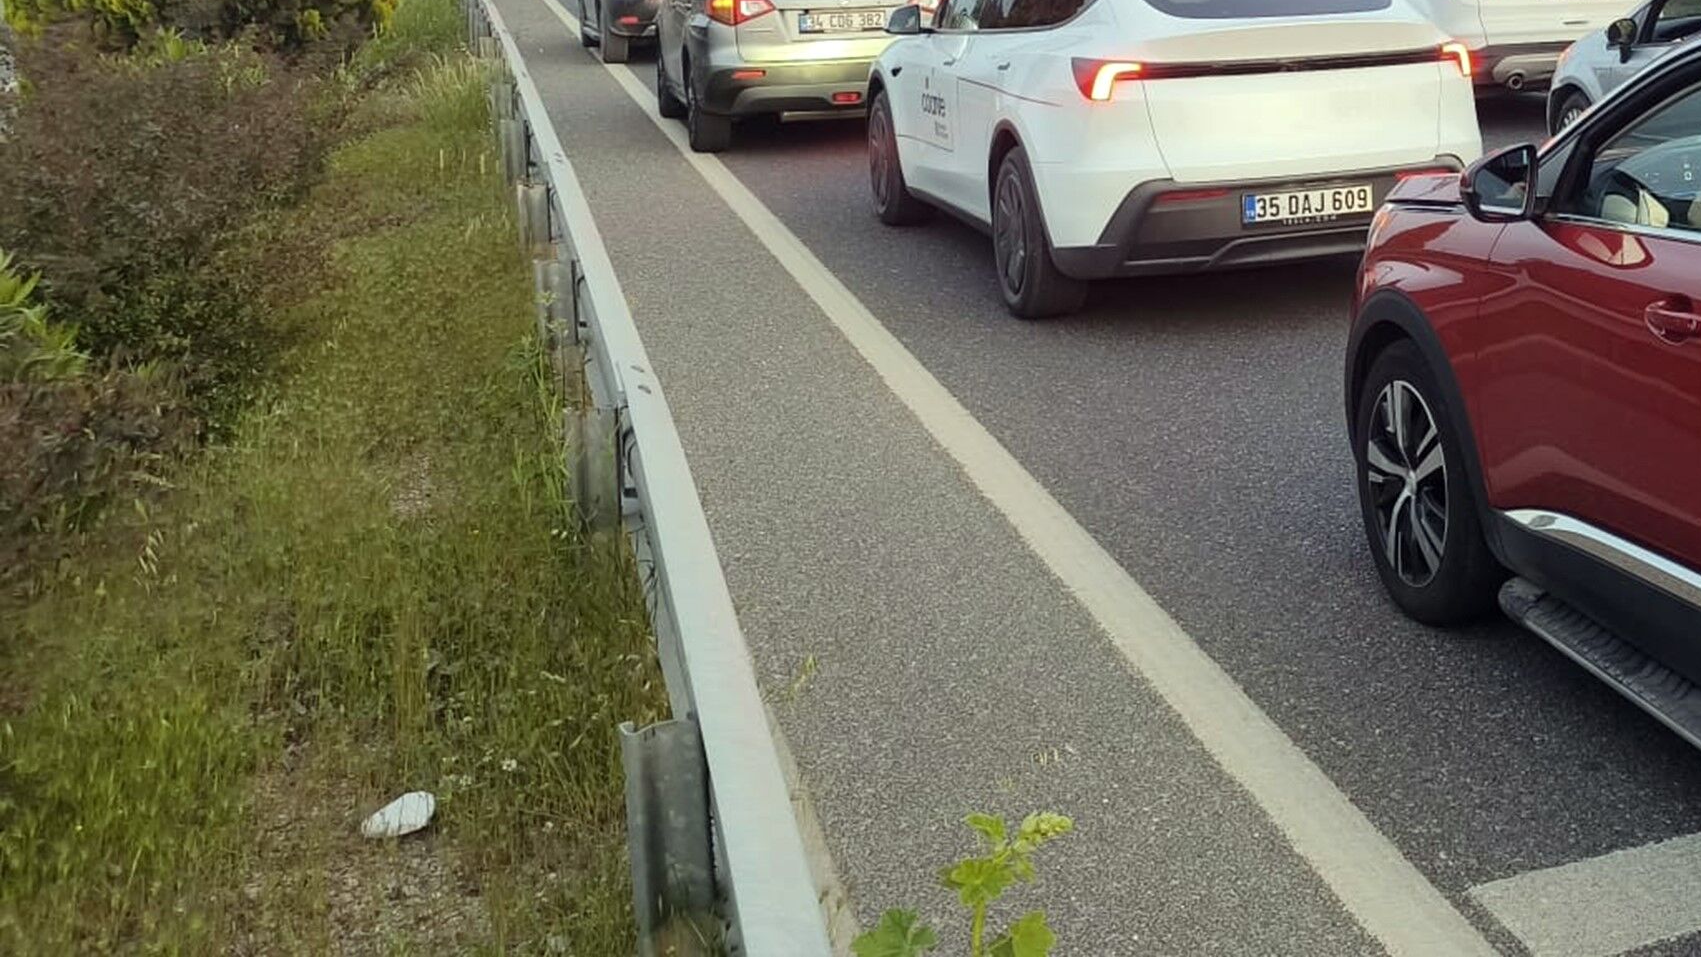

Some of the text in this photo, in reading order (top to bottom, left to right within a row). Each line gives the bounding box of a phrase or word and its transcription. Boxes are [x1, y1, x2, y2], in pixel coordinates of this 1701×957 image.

[1257, 197, 1280, 218] 35
[1288, 192, 1325, 216] DAJ
[1332, 188, 1369, 211] 609
